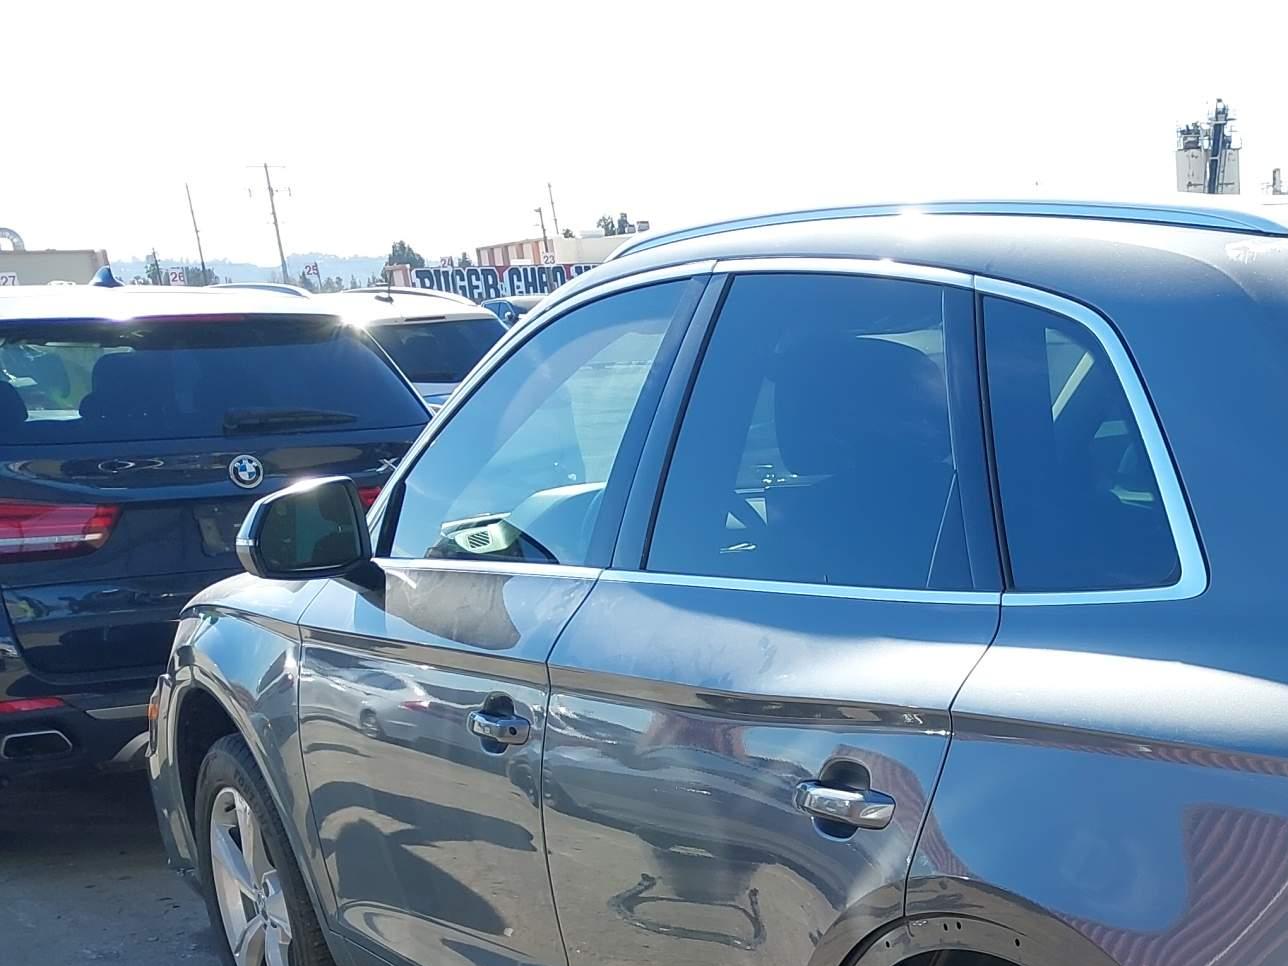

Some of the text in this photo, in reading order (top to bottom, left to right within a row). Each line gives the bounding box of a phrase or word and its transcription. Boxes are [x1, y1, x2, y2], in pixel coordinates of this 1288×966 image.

[543, 255, 556, 265] 23
[304, 264, 318, 276] 25
[0, 275, 16, 286] 27
[170, 271, 185, 282] 26
